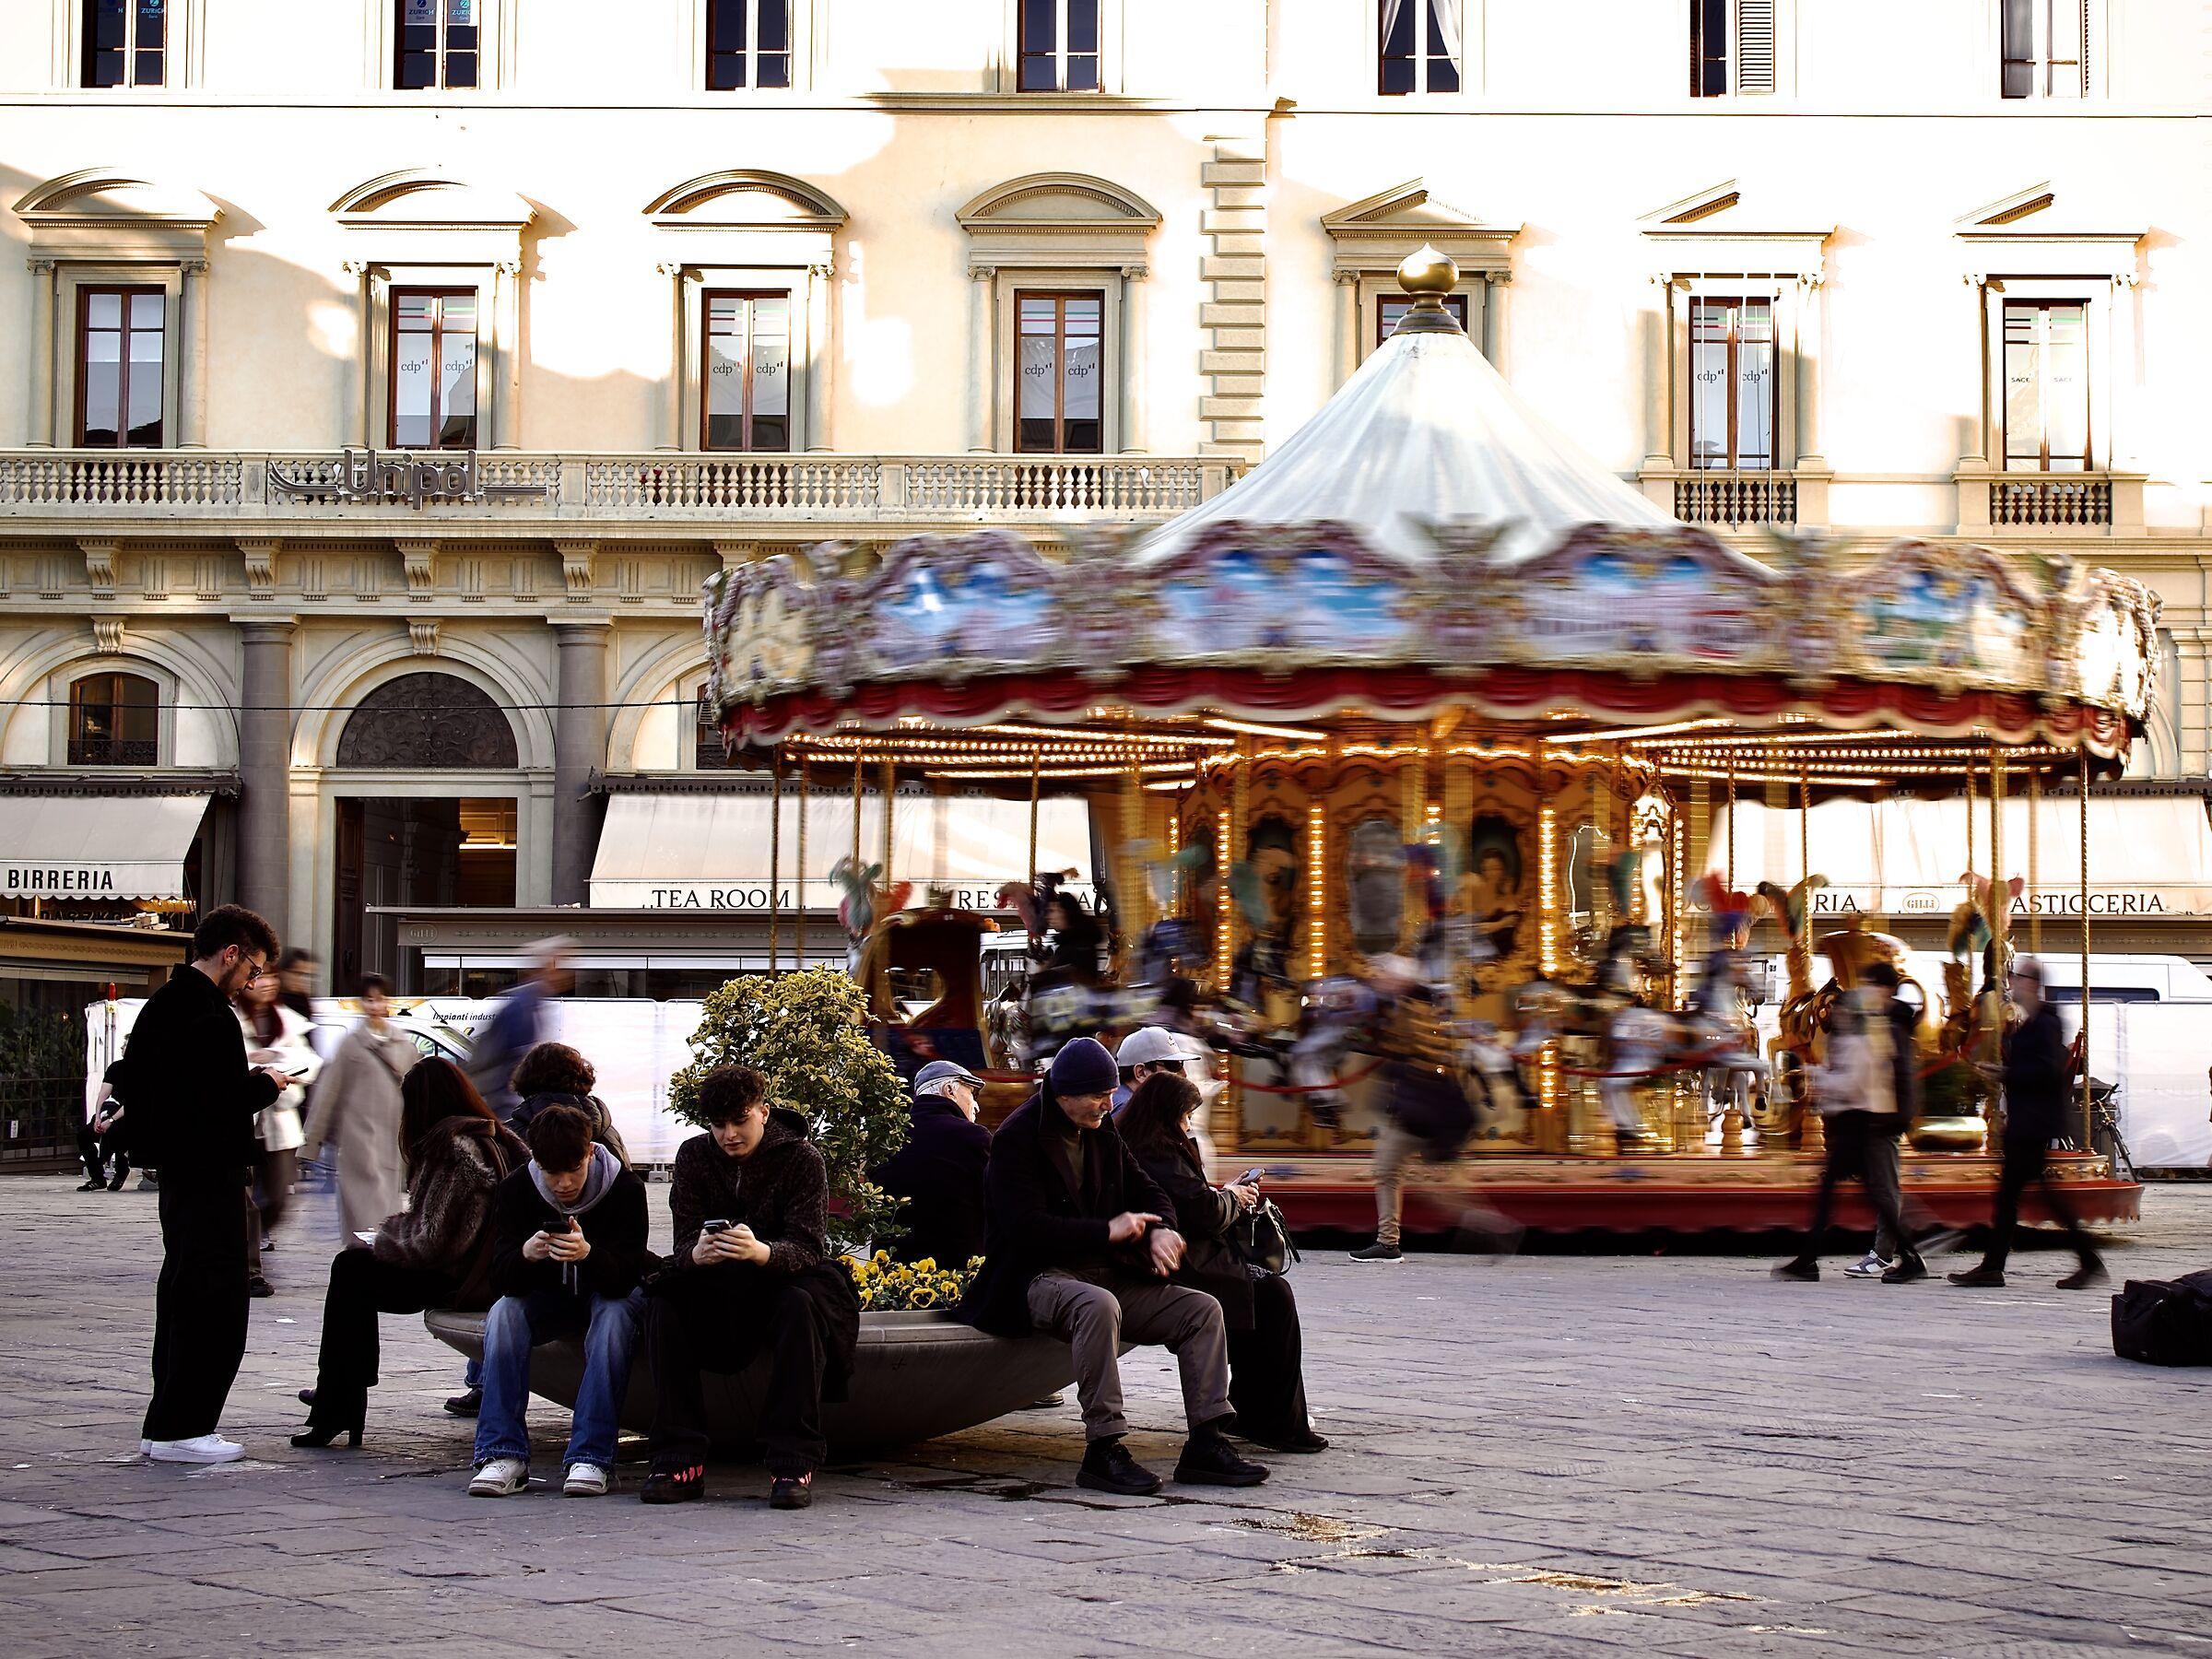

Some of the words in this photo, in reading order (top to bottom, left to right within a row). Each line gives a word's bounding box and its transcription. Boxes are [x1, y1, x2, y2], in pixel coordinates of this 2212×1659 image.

[344, 449, 477, 511] Unipol
[7, 869, 113, 890] BIRRERIA
[652, 889, 700, 908] TEA
[710, 889, 790, 909] ROOM
[2010, 893, 2164, 914] ASTICCERIA
[469, 1012, 497, 1021] indust
